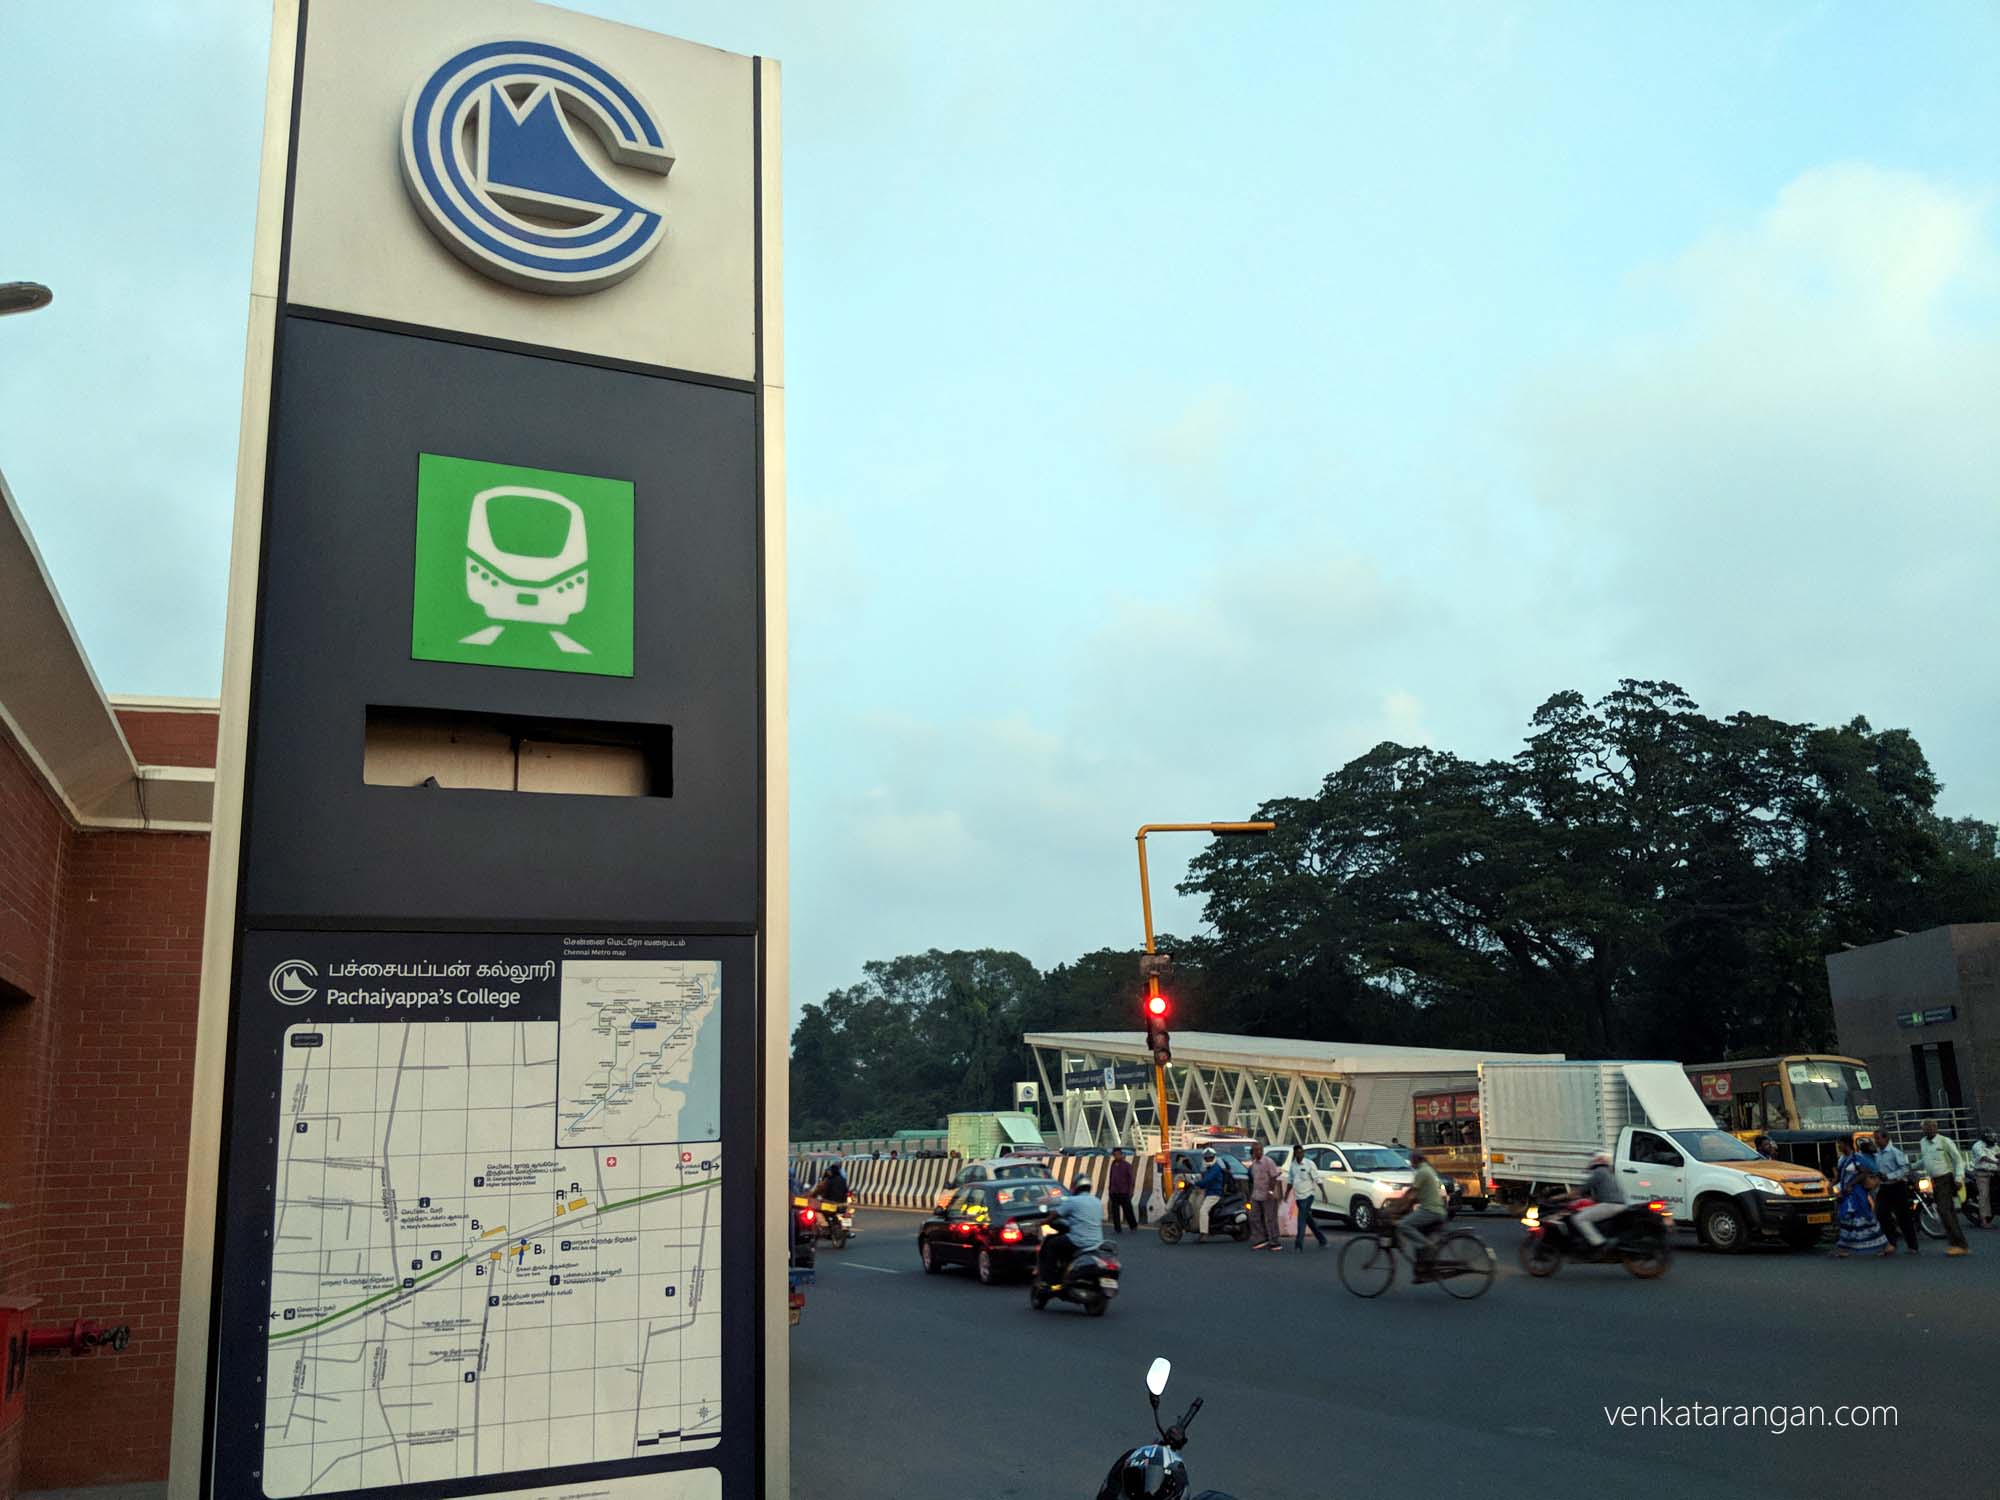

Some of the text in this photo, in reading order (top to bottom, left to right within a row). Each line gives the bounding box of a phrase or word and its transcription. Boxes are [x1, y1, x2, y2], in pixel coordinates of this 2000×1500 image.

[612, 949, 627, 957] map
[328, 959, 556, 984] பச்சையப்பன் கல்லூரி
[456, 988, 521, 1008] College
